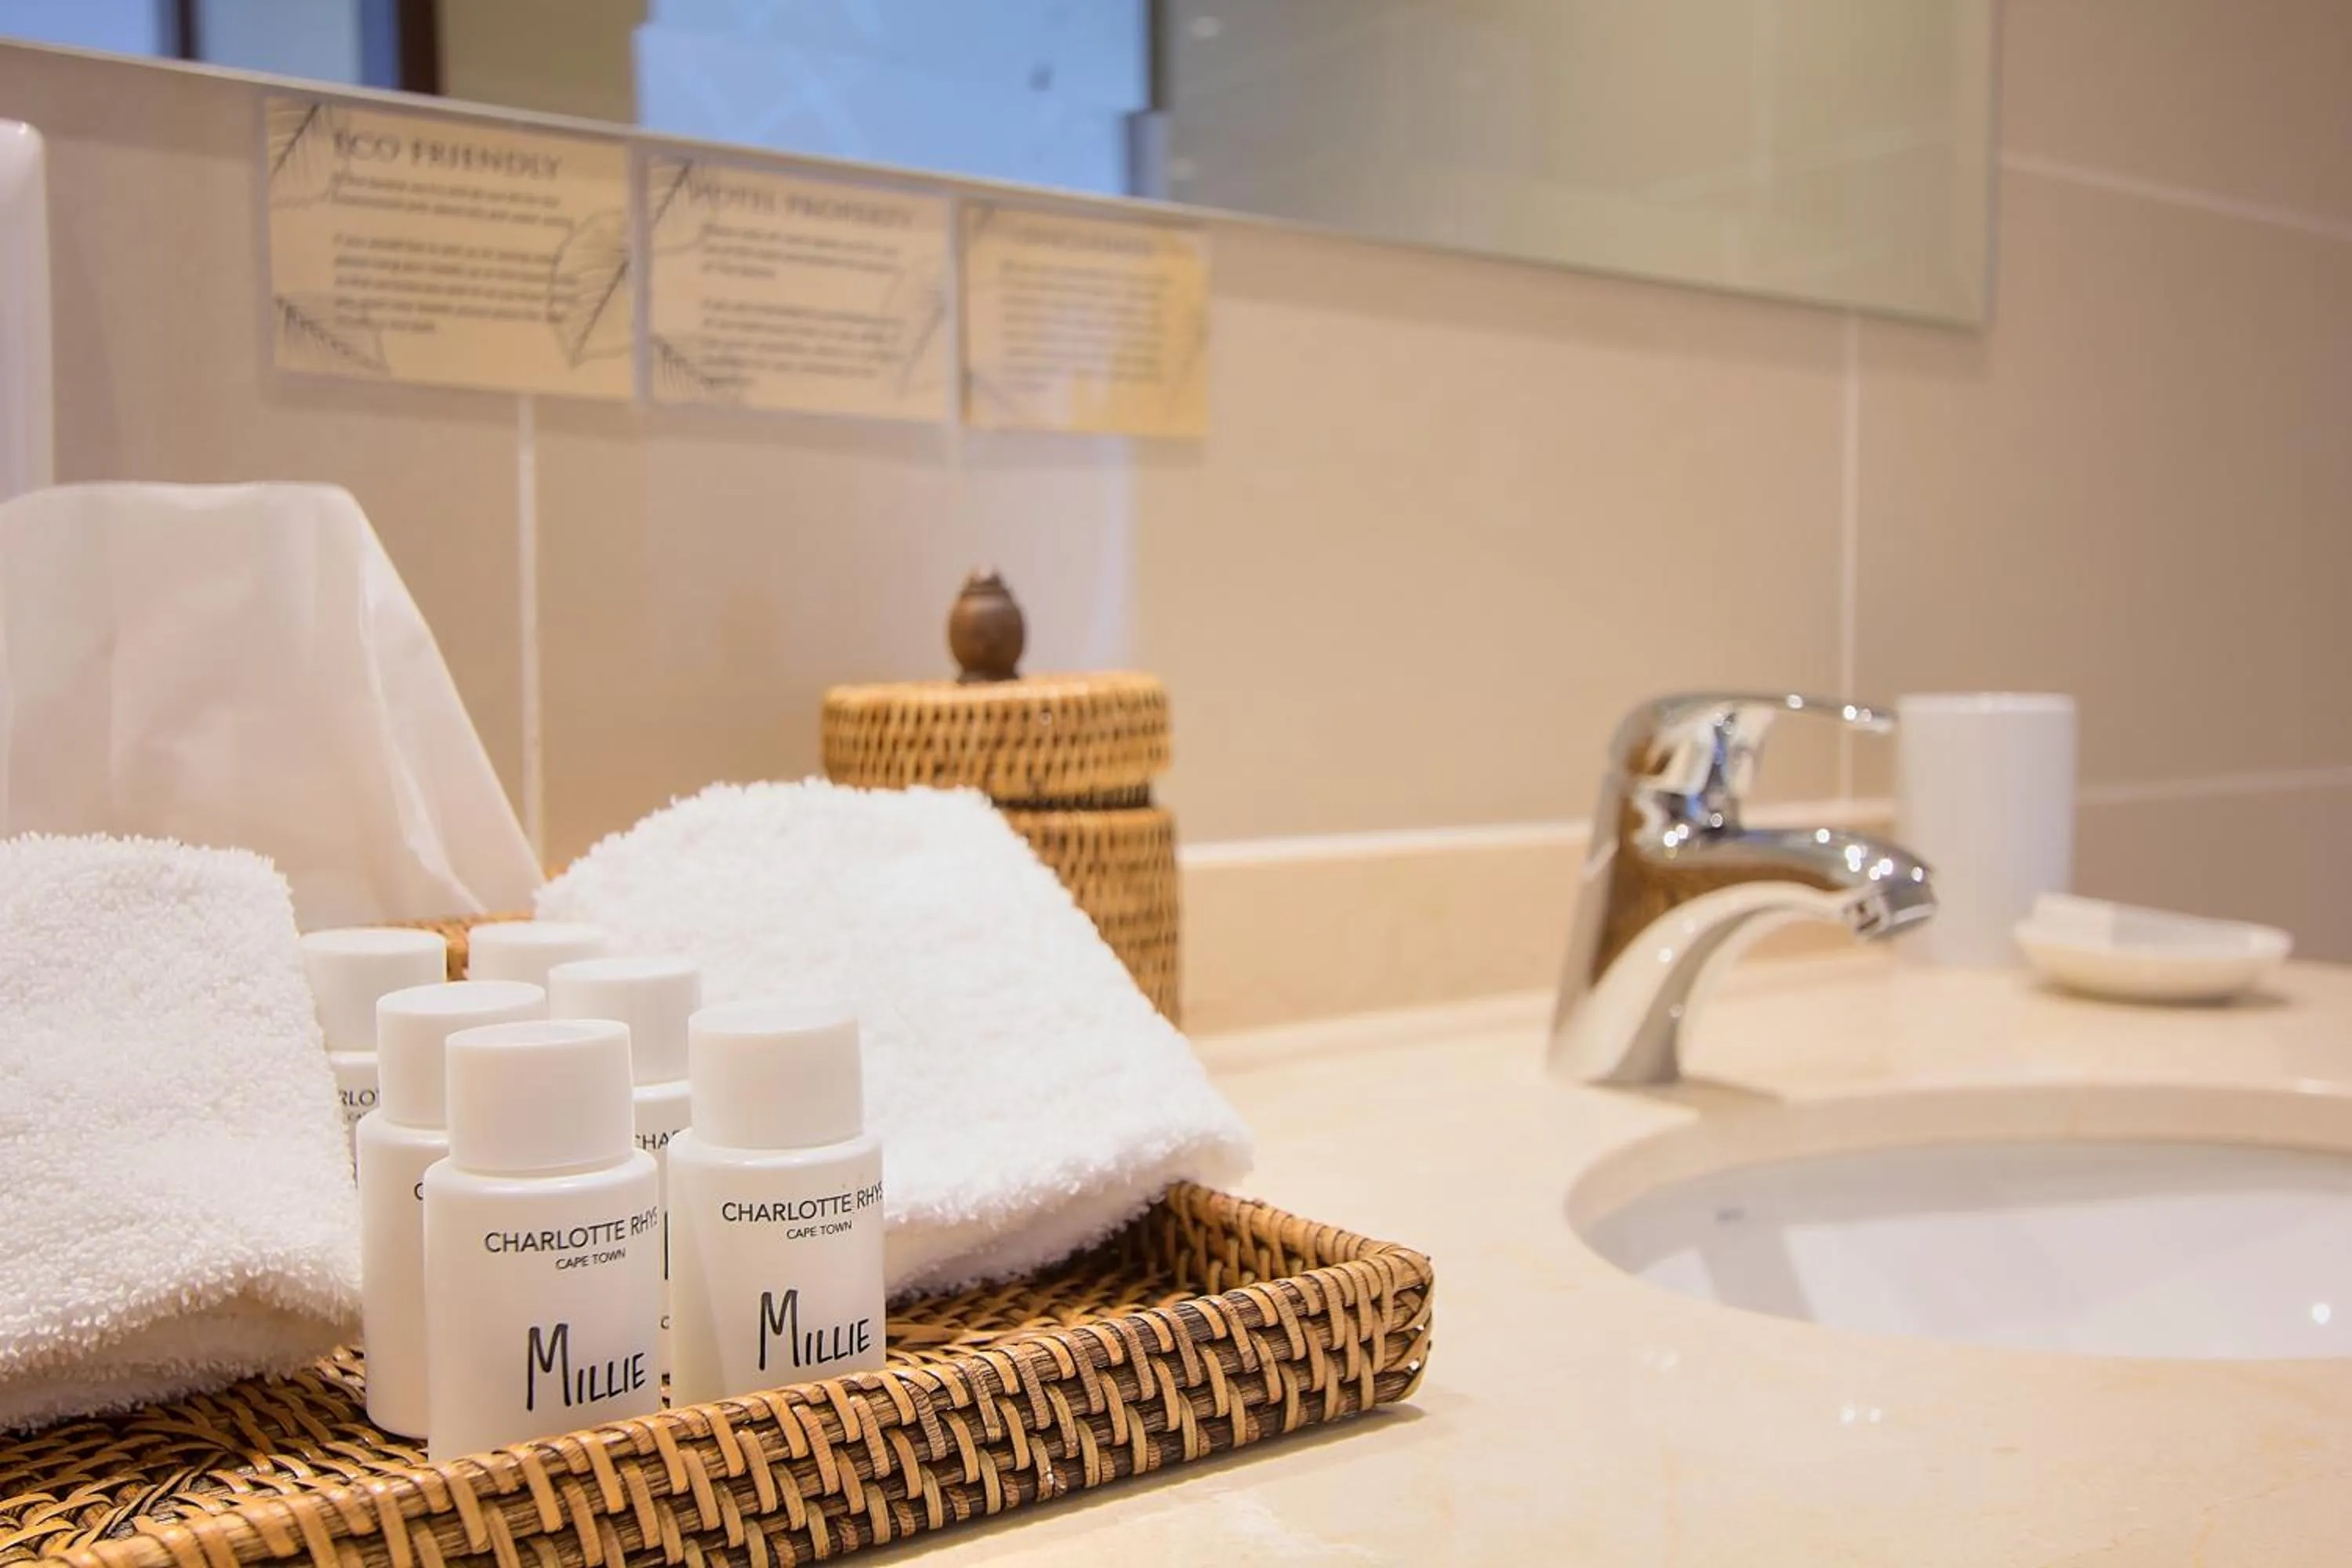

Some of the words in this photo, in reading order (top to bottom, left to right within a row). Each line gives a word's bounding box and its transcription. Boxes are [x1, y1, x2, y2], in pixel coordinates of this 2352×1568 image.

[721, 1193, 852, 1222] CHARLOTTE
[485, 1219, 626, 1254] CHARLOTTE
[786, 1225, 817, 1240] CAPE
[821, 1220, 853, 1236] TOWN
[555, 1254, 590, 1270] CAPE
[591, 1247, 626, 1265] TOWN
